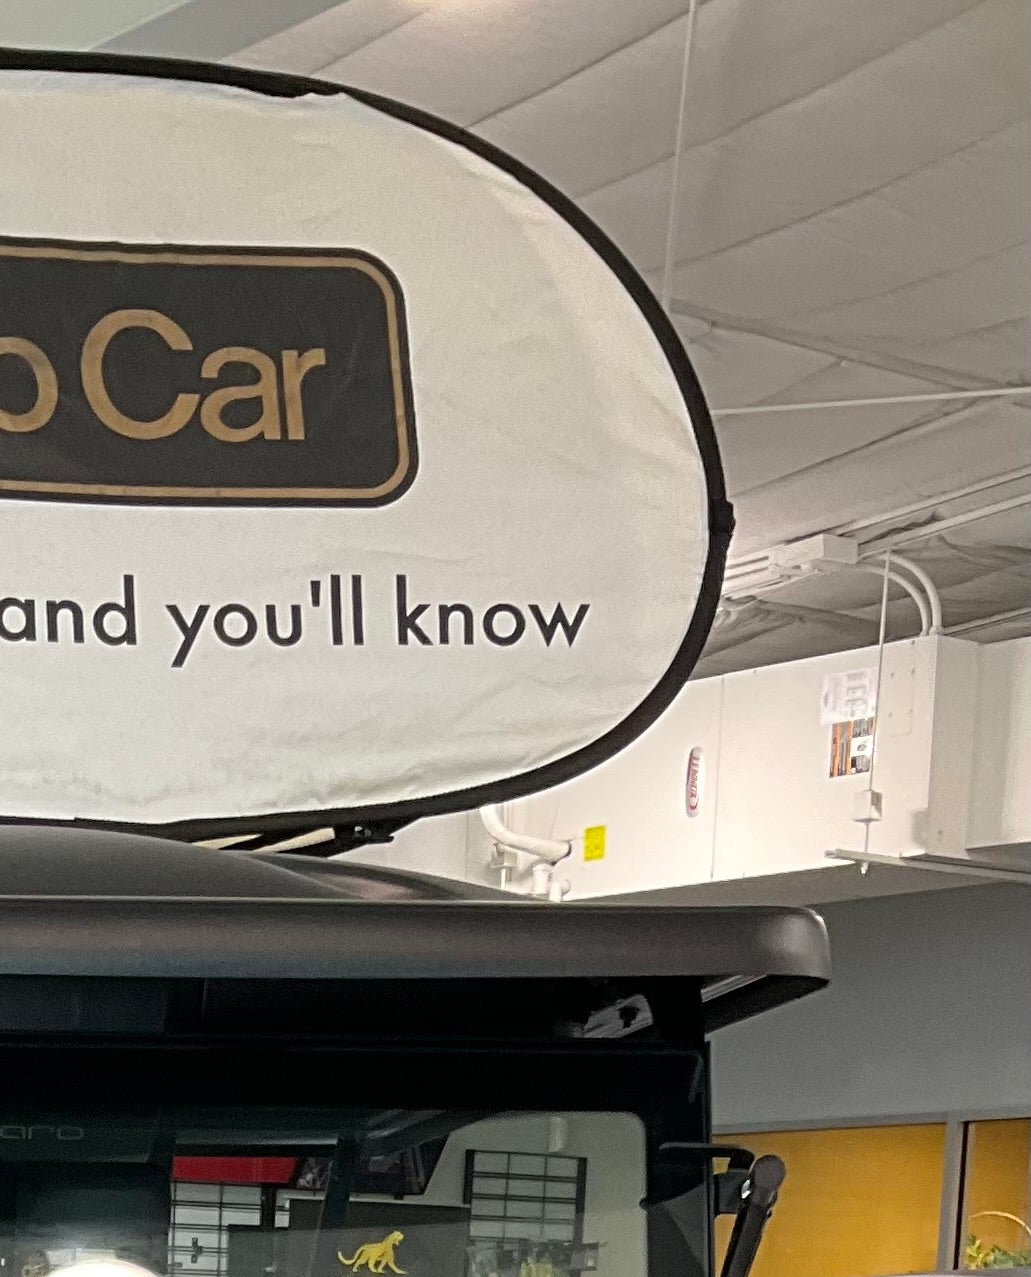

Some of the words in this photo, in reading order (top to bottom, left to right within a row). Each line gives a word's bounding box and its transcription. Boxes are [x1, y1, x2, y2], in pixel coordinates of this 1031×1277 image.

[80, 309, 325, 443] Car
[166, 575, 364, 668] you'll
[396, 575, 590, 647] know
